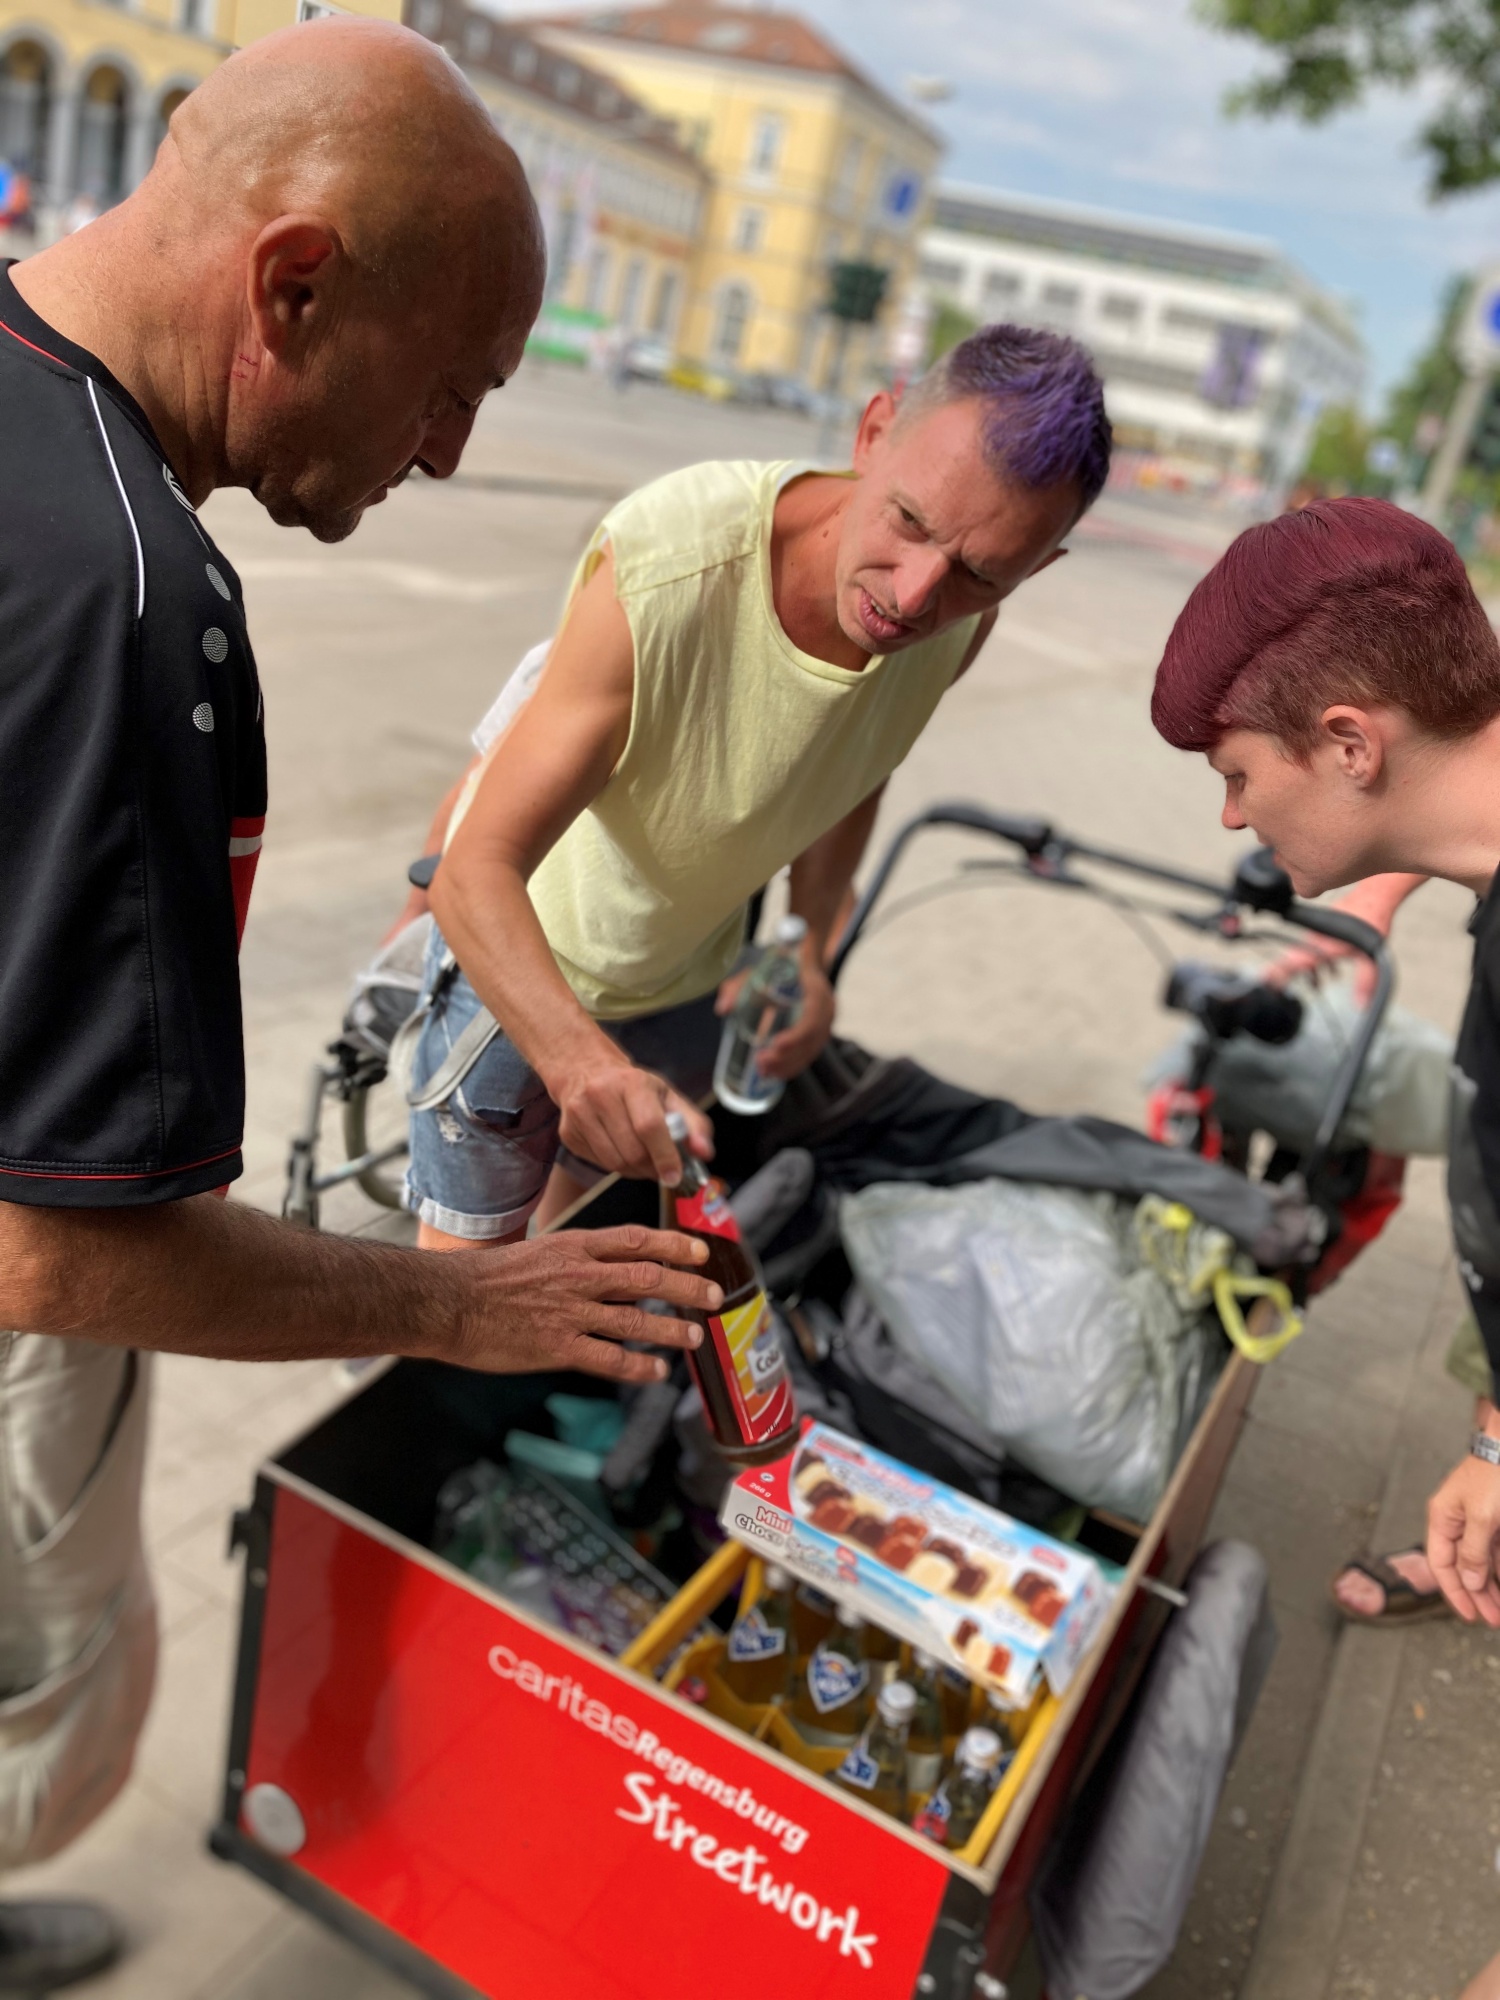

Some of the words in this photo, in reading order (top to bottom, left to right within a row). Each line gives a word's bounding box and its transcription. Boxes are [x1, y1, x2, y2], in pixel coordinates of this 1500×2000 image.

[734, 1513, 782, 1547] Choco
[755, 1505, 792, 1535] Mini
[614, 1772, 878, 1969] Streetwork
